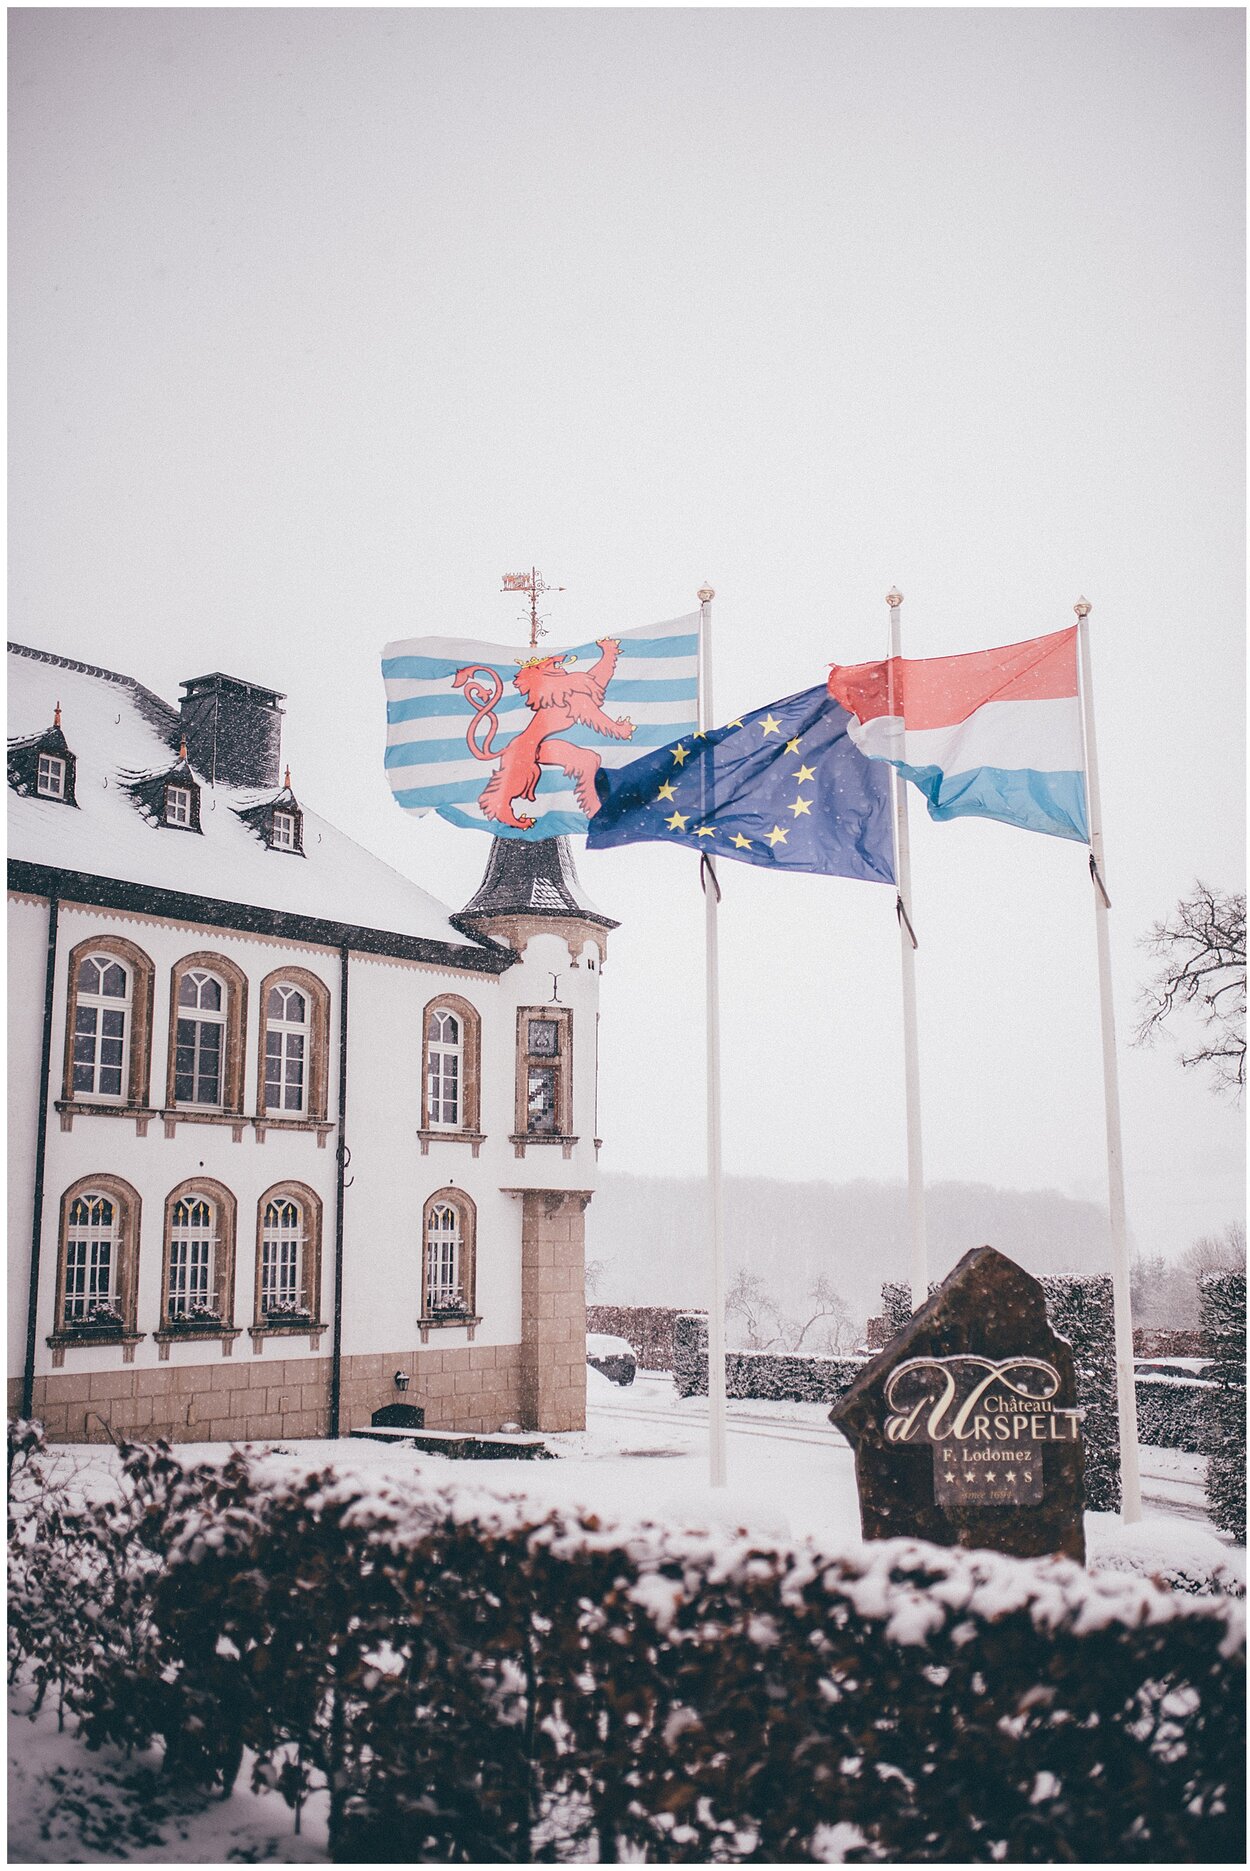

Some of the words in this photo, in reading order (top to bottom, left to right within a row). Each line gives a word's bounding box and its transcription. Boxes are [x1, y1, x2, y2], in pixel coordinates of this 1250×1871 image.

[983, 1396, 1052, 1413] Château
[943, 1449, 957, 1462] F.
[963, 1448, 1032, 1462] Lodomez
